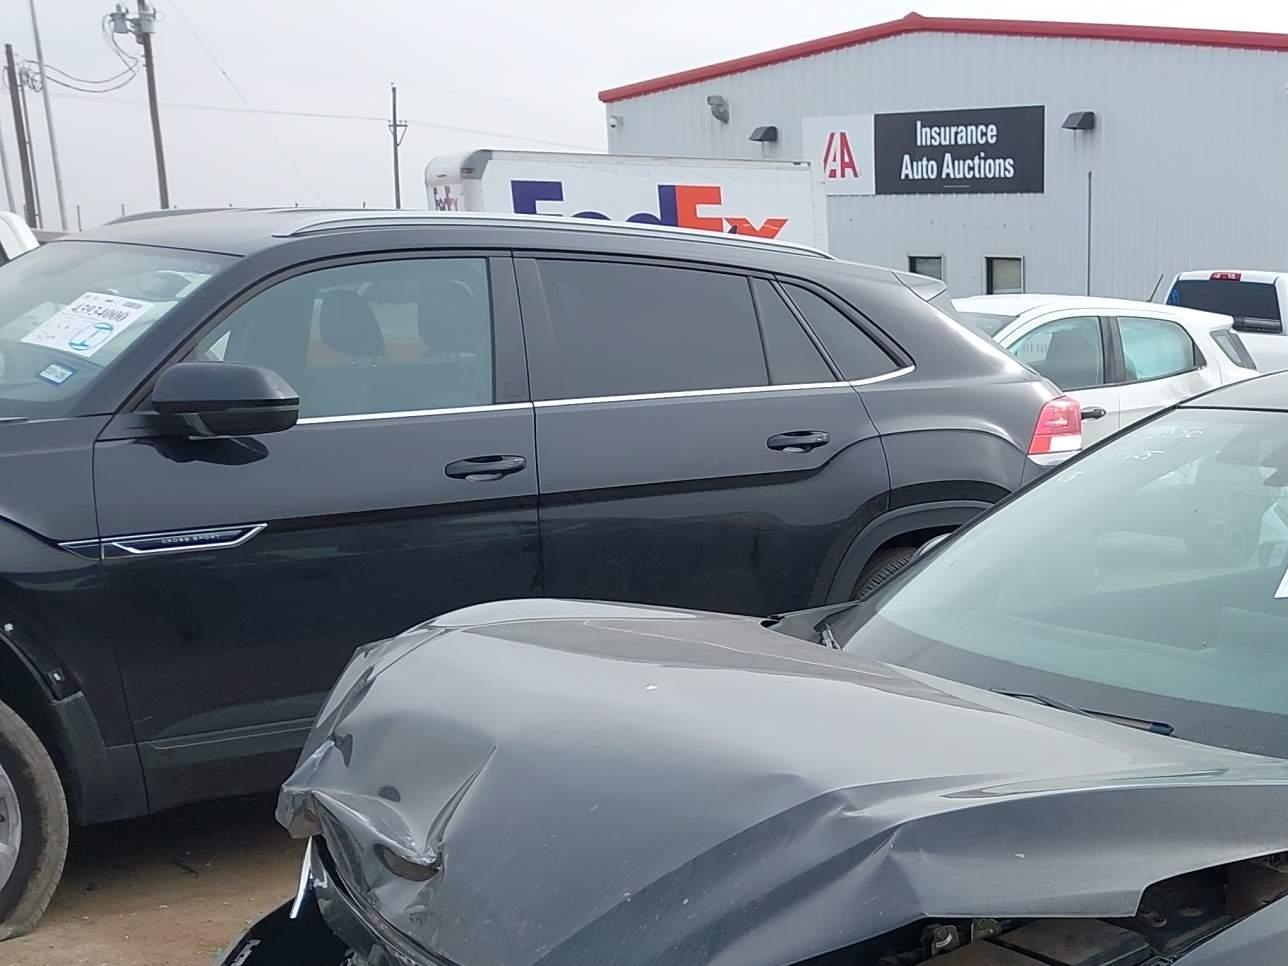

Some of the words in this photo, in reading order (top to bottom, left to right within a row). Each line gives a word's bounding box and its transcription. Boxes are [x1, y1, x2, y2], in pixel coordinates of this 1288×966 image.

[916, 120, 998, 146] Insurance
[901, 154, 938, 180] Auto
[942, 152, 1015, 178] Auctions
